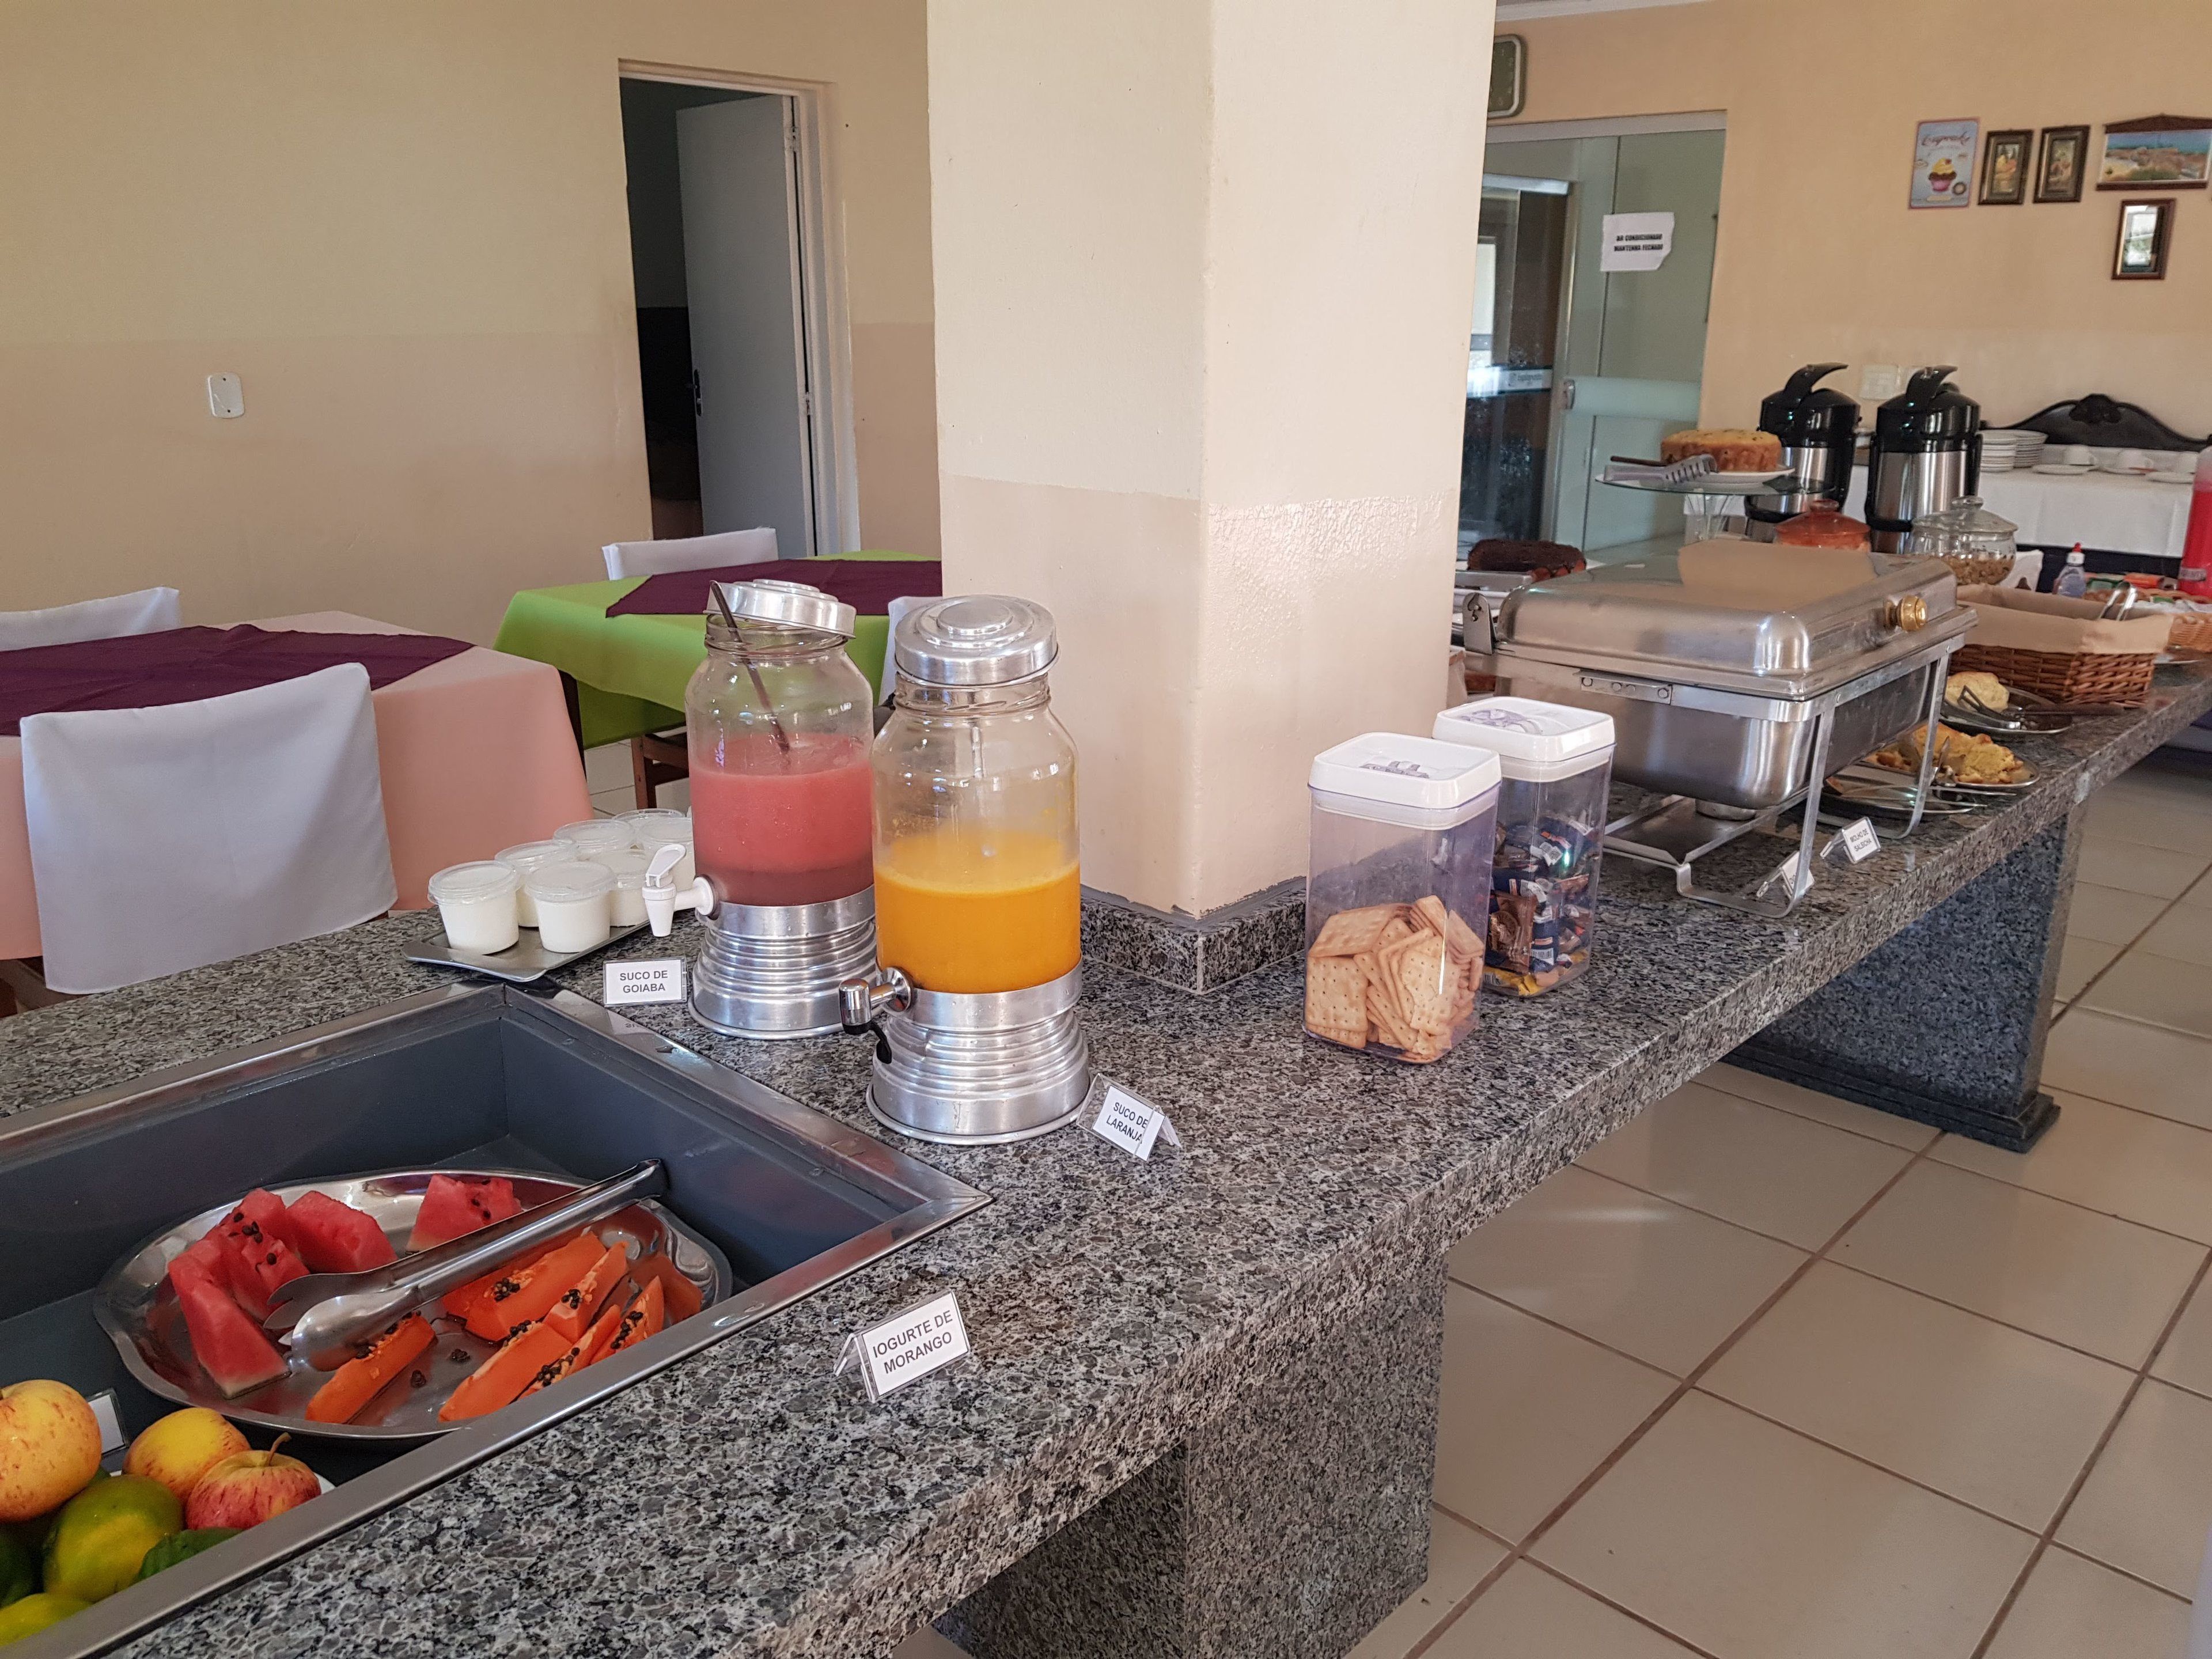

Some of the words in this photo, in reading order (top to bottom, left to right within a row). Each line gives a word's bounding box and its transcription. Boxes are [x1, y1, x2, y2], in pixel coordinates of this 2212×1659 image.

[620, 971, 650, 980] SUCO
[654, 970, 668, 979] DE
[623, 983, 665, 993] GOIABA
[1113, 1102, 1135, 1121] SUCO
[1136, 1115, 1149, 1128] DE
[1106, 1115, 1143, 1144] LARANJA
[872, 1320, 933, 1358] IOGURTE
[934, 1310, 953, 1328] DE
[884, 1331, 952, 1374] MORANGO
